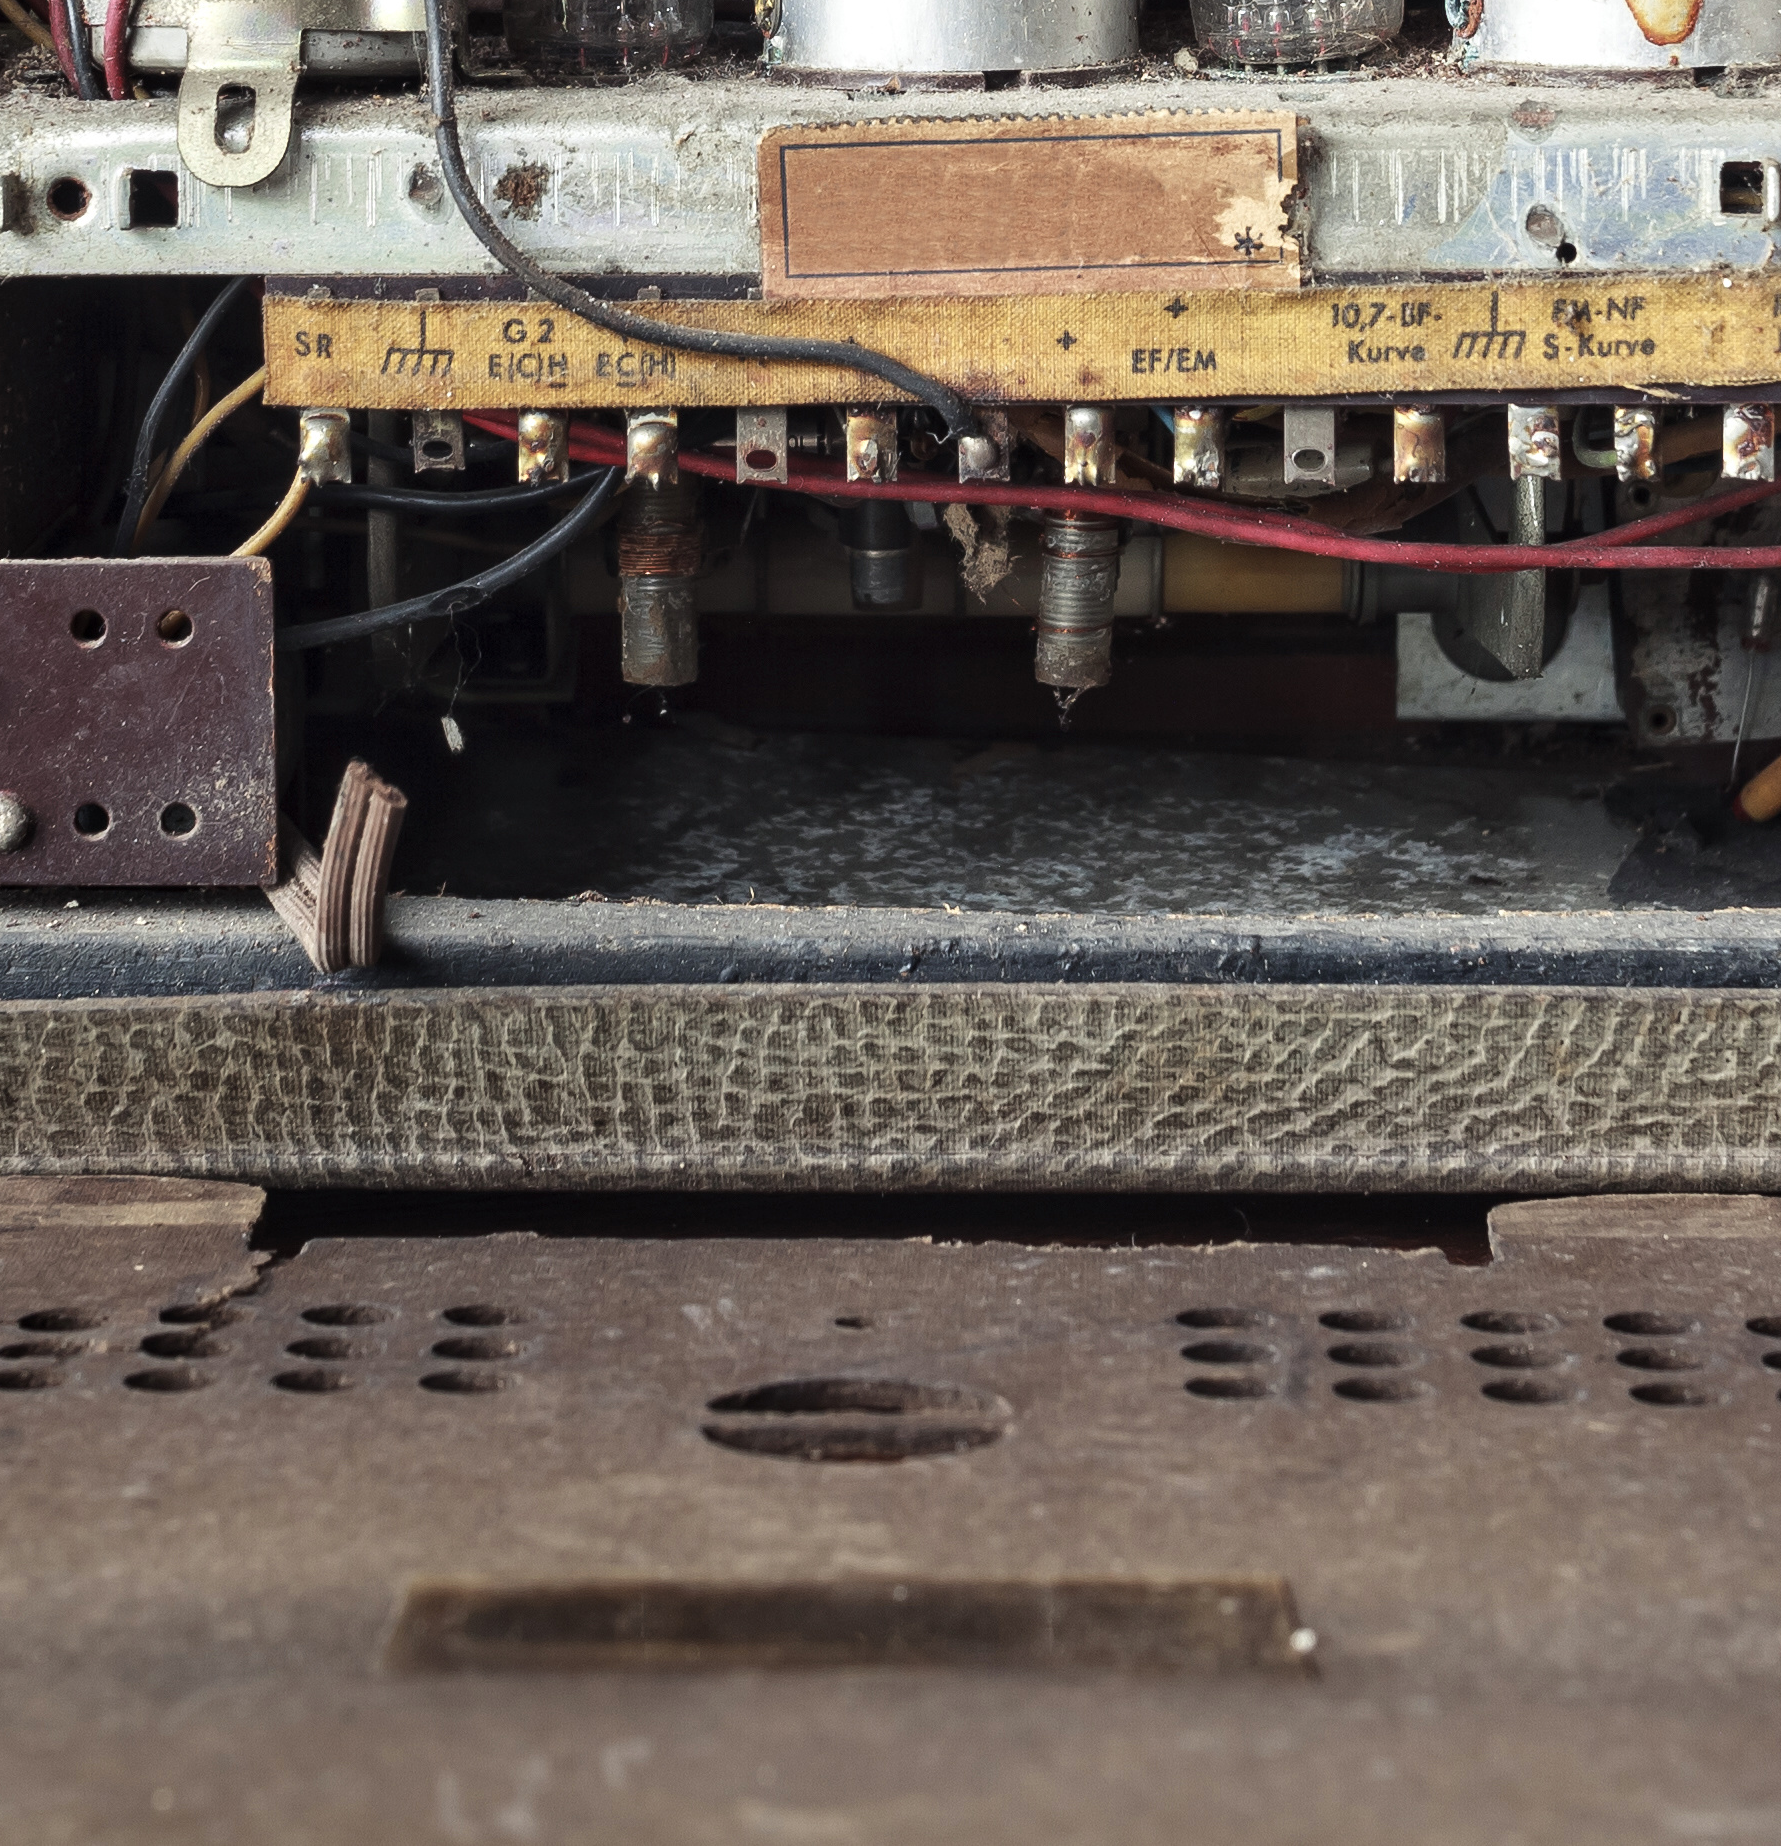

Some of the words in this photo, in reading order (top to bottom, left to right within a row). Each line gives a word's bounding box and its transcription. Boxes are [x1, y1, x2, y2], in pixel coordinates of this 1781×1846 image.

[295, 330, 333, 358] SR
[1348, 339, 1426, 364] Kurve
[1132, 347, 1217, 374] EF/EM
